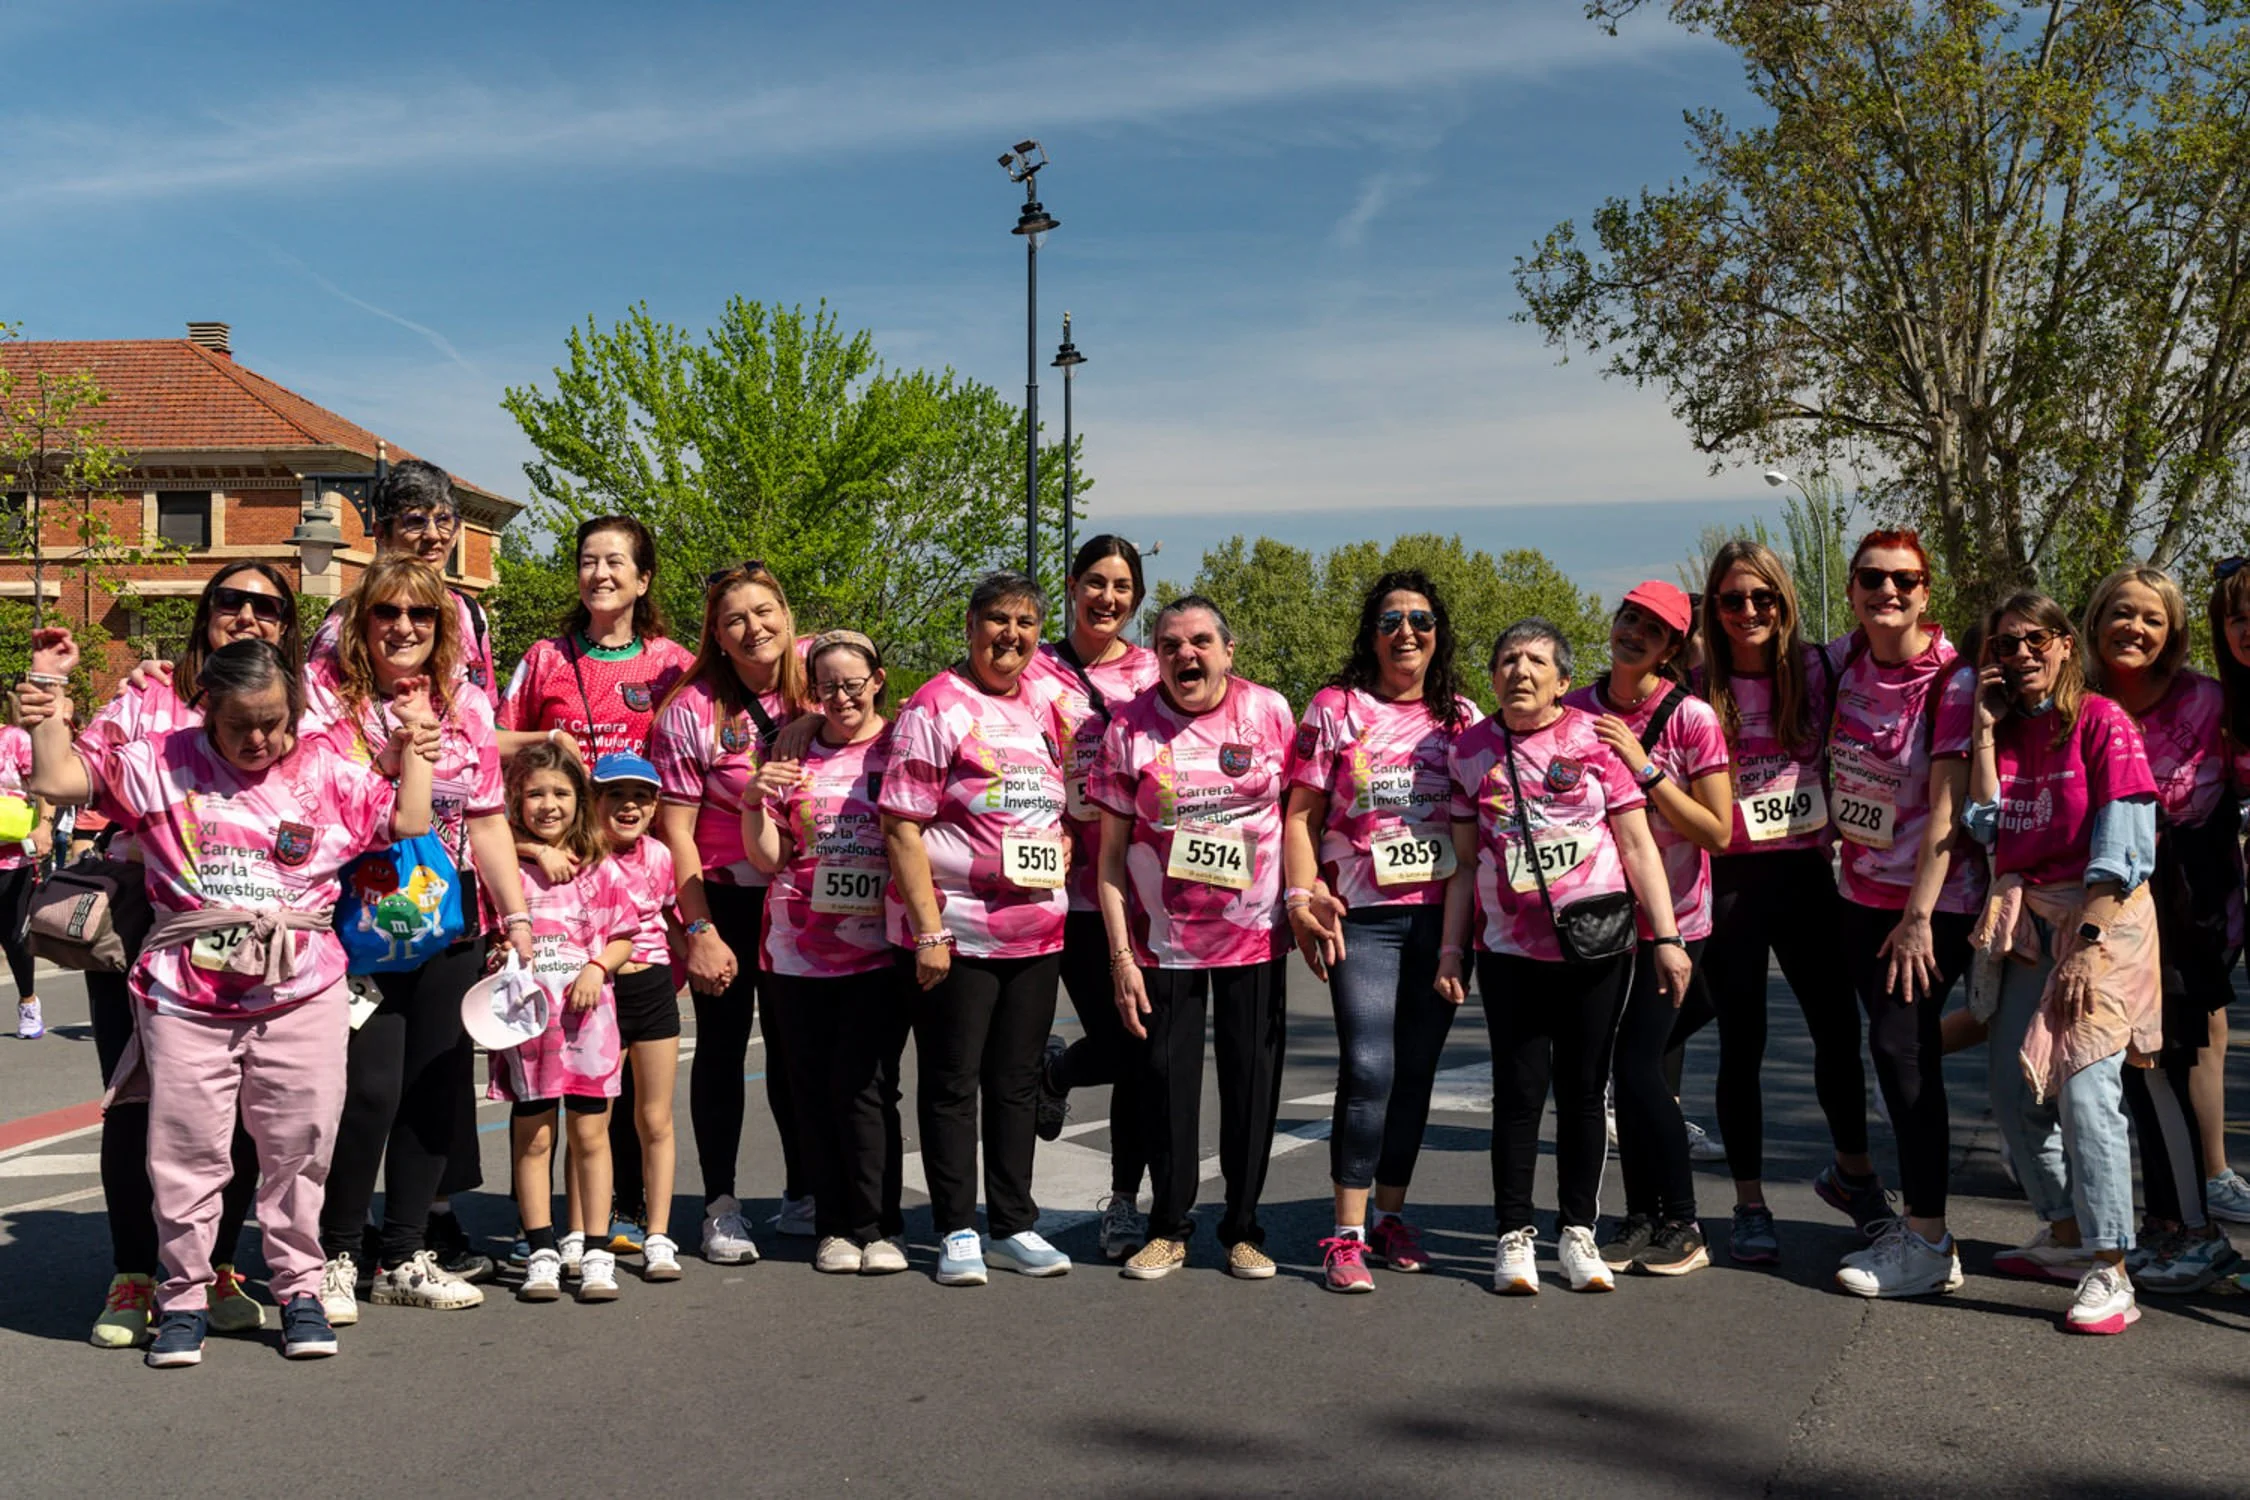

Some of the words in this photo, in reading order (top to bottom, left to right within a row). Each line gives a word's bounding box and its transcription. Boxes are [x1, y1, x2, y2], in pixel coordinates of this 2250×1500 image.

[571, 719, 627, 733] Carrera
[996, 748, 1008, 759] XI
[1738, 751, 1790, 766] Carrera
[1001, 763, 1047, 775] Carrera
[1370, 762, 1423, 775] Carrera
[1176, 772, 1189, 783] XI
[1740, 773, 1760, 784] por
[1764, 769, 1777, 780] la
[1004, 780, 1026, 794] por
[1028, 779, 1040, 791] la
[1177, 784, 1233, 799] Carrera
[1371, 780, 1394, 794] por
[1398, 777, 1411, 789] la
[814, 797, 828, 809] XI
[1177, 803, 1201, 817] por
[1753, 792, 1812, 824] 5849
[814, 813, 867, 826] Carrera
[1839, 799, 1883, 831] 2228
[200, 821, 217, 837] XI
[841, 829, 853, 840] la
[200, 840, 266, 862] Carrera
[1018, 845, 1057, 872] 5513
[1186, 839, 1242, 871] 5514
[1385, 839, 1443, 867] 2859
[201, 863, 228, 876] por
[232, 864, 248, 878] la
[826, 872, 881, 899] 5501
[391, 920, 410, 934] m
[532, 933, 567, 943] arrera
[544, 948, 556, 957] la
